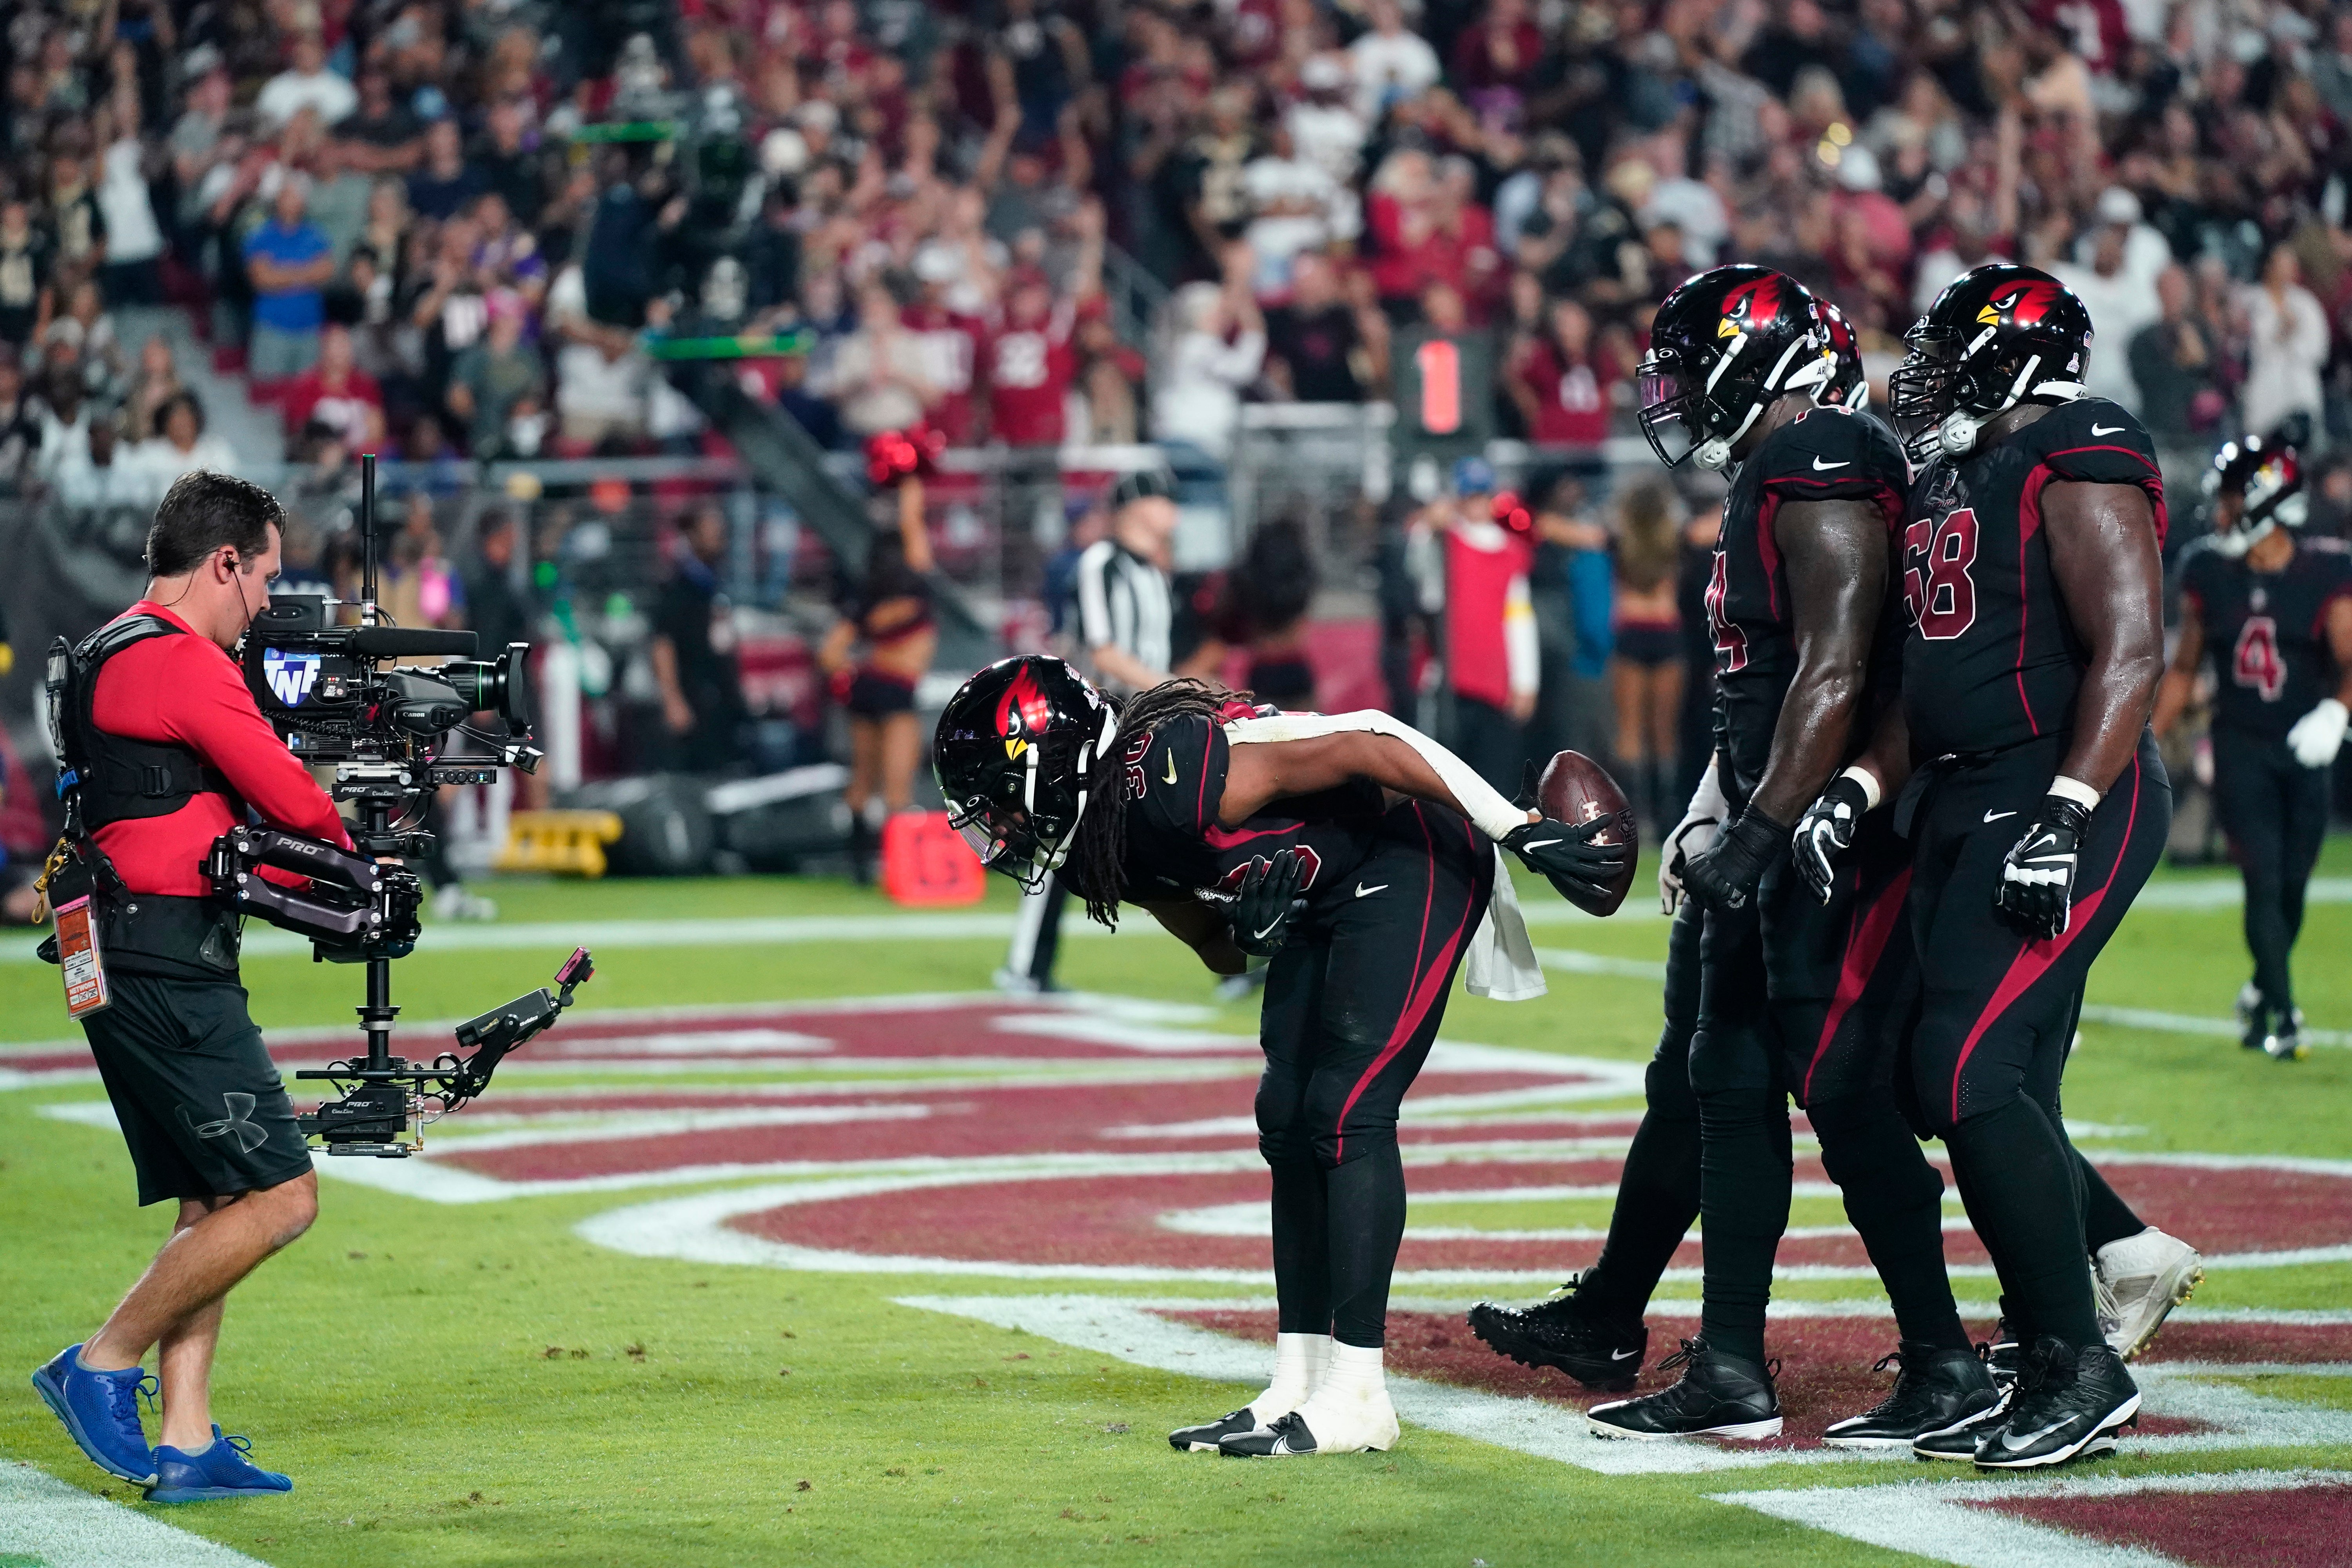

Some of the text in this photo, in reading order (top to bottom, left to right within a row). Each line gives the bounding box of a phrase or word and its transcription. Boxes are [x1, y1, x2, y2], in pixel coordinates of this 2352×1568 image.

[1416, 340, 1461, 434] 1
[1903, 507, 1979, 640] 68
[264, 660, 320, 704] TNF
[2233, 616, 2287, 702] 4
[276, 837, 325, 855] PRO
[69, 980, 96, 995] NETWORK
